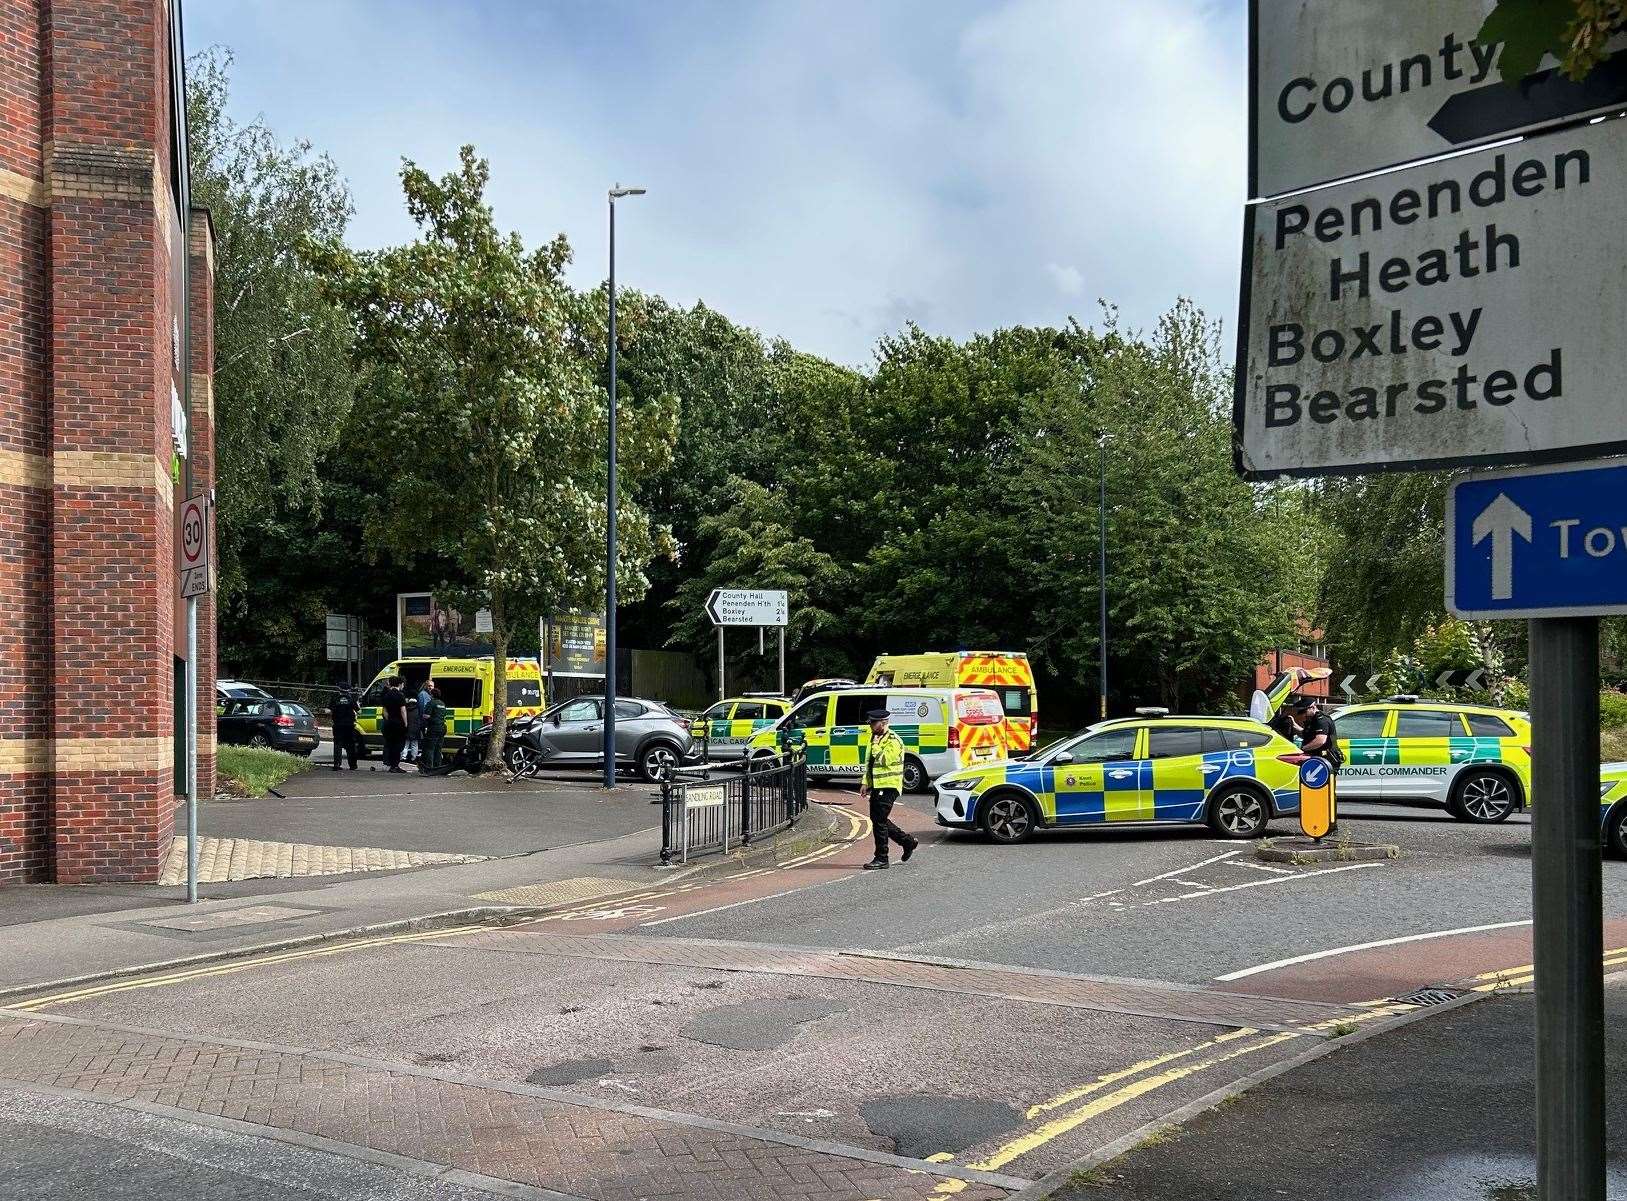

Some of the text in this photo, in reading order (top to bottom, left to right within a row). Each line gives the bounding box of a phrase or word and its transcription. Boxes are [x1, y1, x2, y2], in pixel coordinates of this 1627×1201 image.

[1277, 32, 1499, 124] County
[1275, 147, 1591, 251] Penenden
[1329, 223, 1521, 301] Heath
[1267, 307, 1483, 368] Boxley
[1264, 348, 1564, 429] Bearsted
[186, 521, 200, 545] 30
[722, 592, 747, 600] County
[749, 592, 764, 600] Hall
[722, 599, 756, 607] Penenden
[722, 608, 746, 616] Boxley
[443, 665, 476, 673] EMERGENCY
[971, 666, 1018, 674] AMBULANCE
[506, 671, 539, 679] BULANCE
[805, 765, 865, 773] AMBULANCE
[1379, 767, 1447, 776] COMMANDER
[708, 790, 722, 800] ROAD
